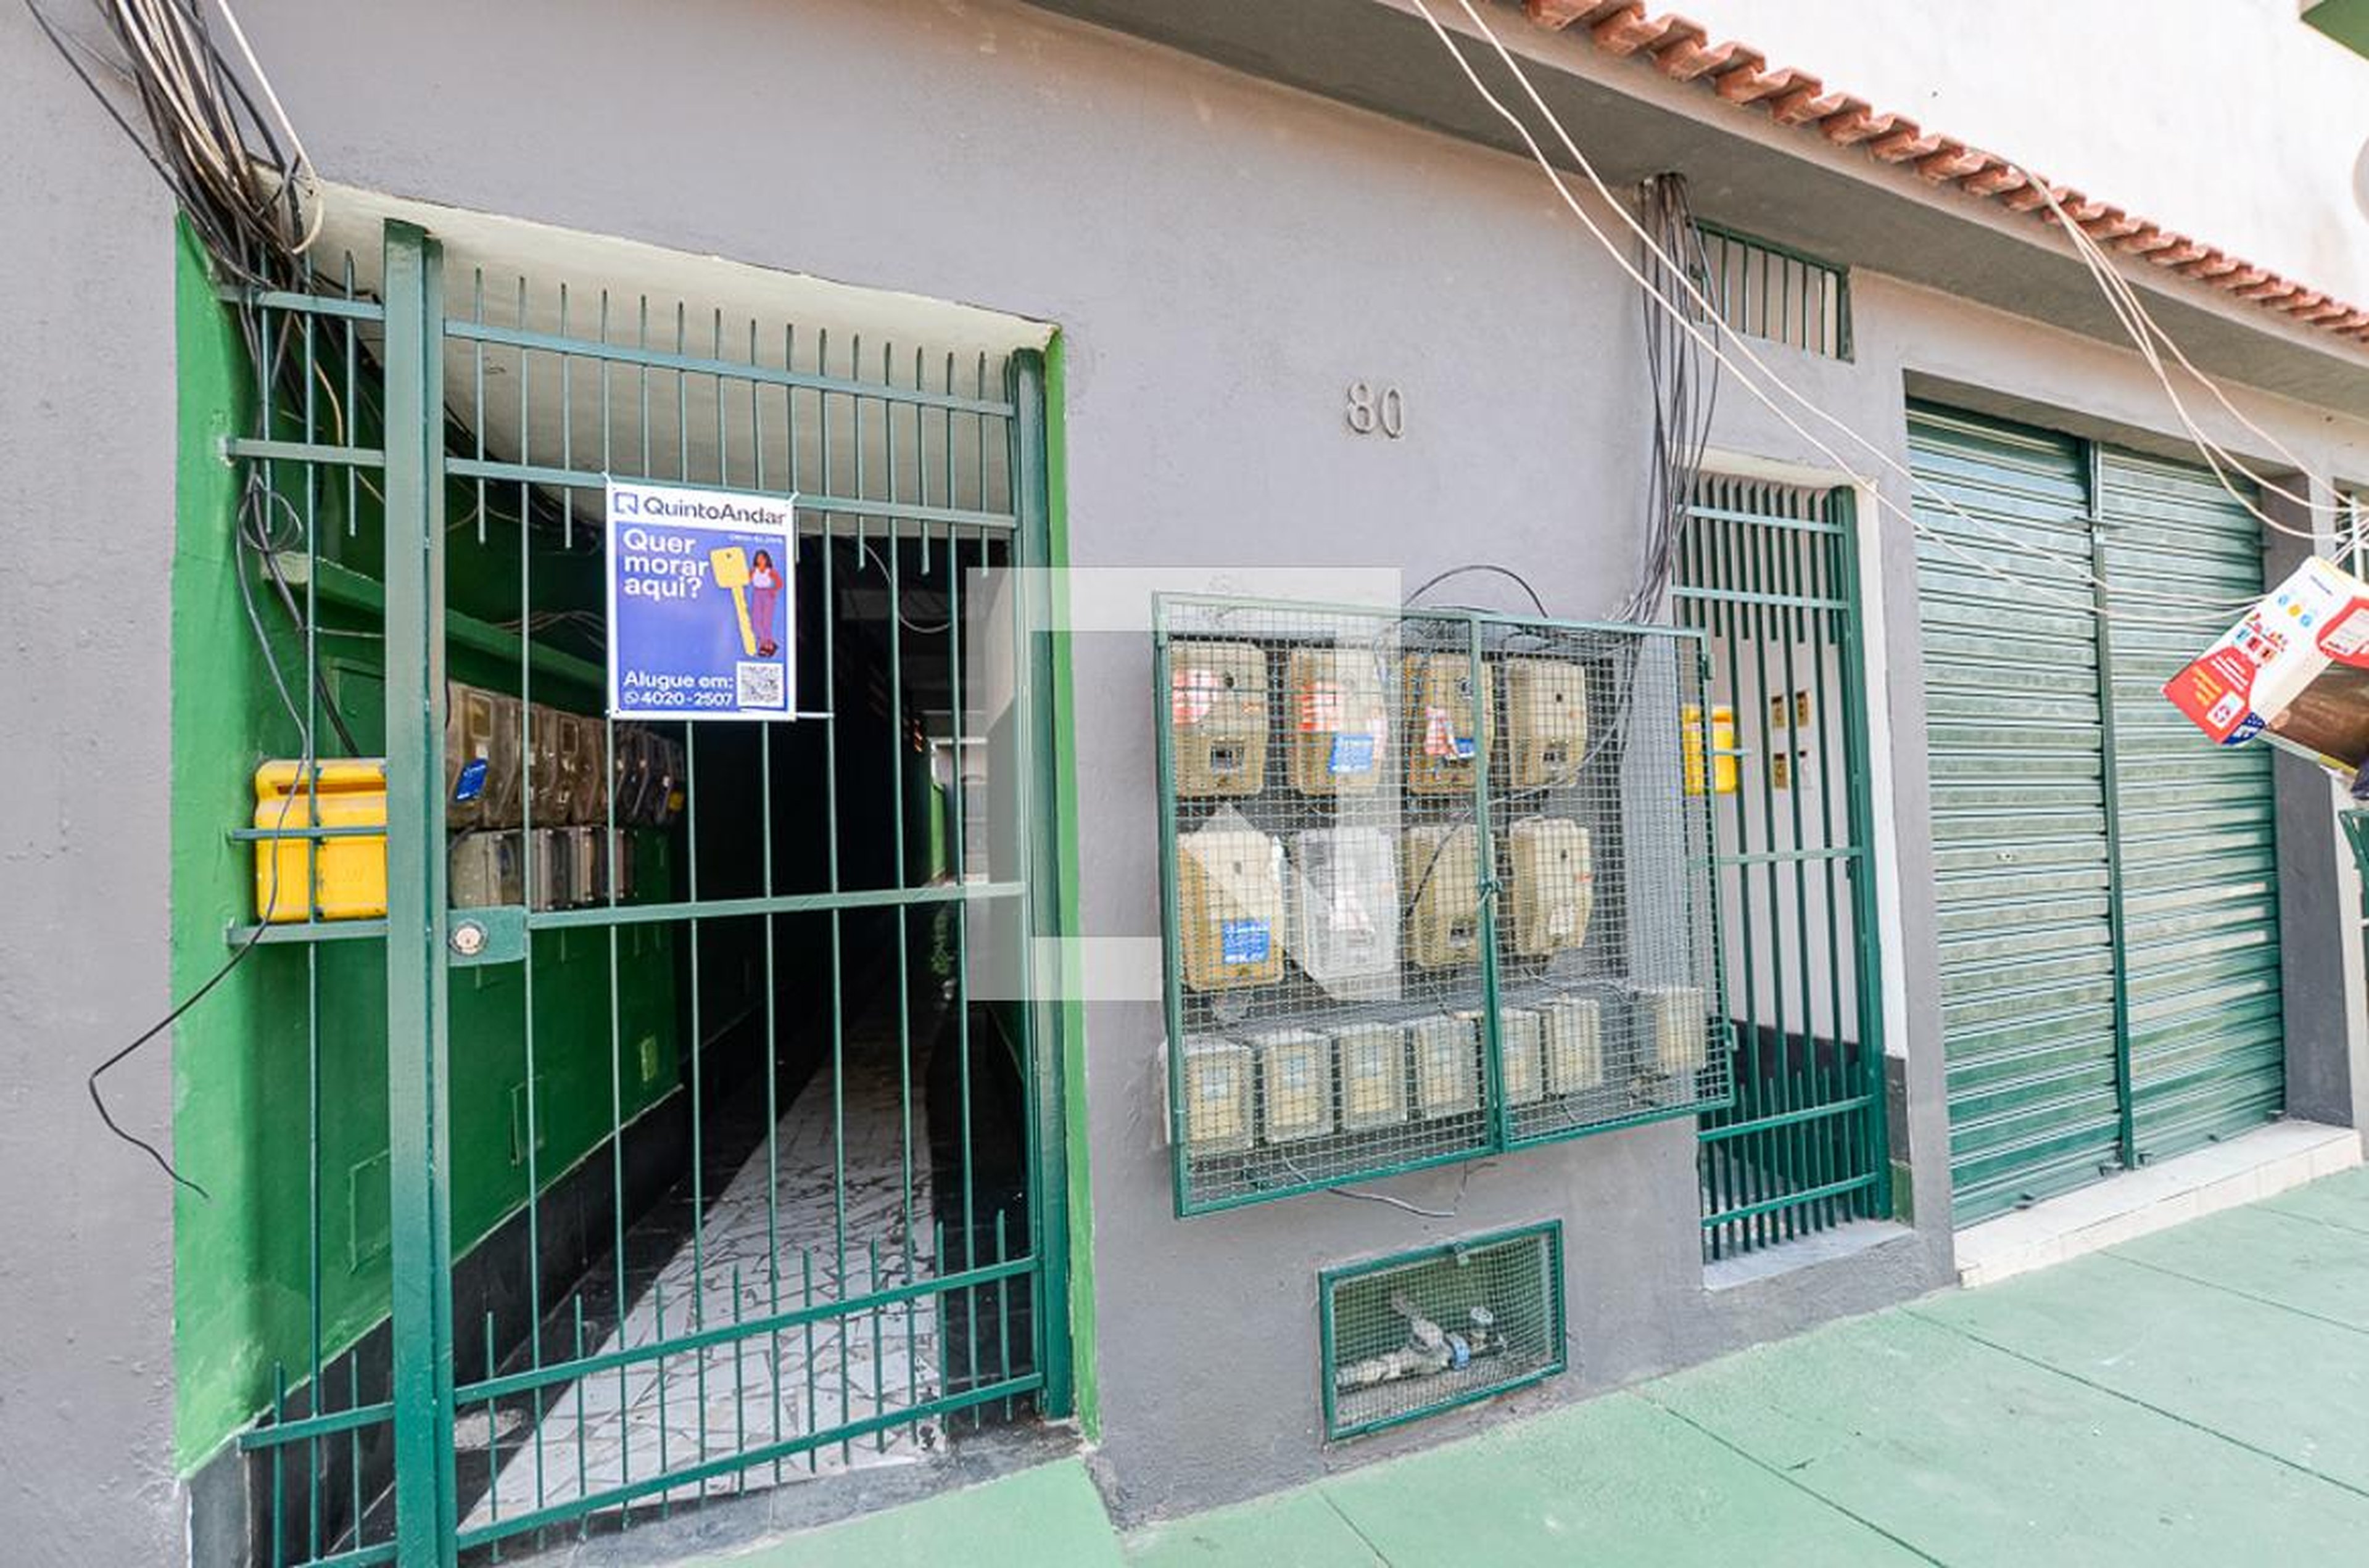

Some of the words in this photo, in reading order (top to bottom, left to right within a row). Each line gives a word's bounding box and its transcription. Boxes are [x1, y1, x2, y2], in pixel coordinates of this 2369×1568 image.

[1346, 383, 1404, 440] 80
[643, 496, 787, 525] QuintoAndar
[623, 528, 697, 553] Quer
[624, 556, 709, 577] morar
[624, 576, 703, 601] aqui?
[623, 670, 695, 691] Alugue
[698, 677, 734, 689] em:
